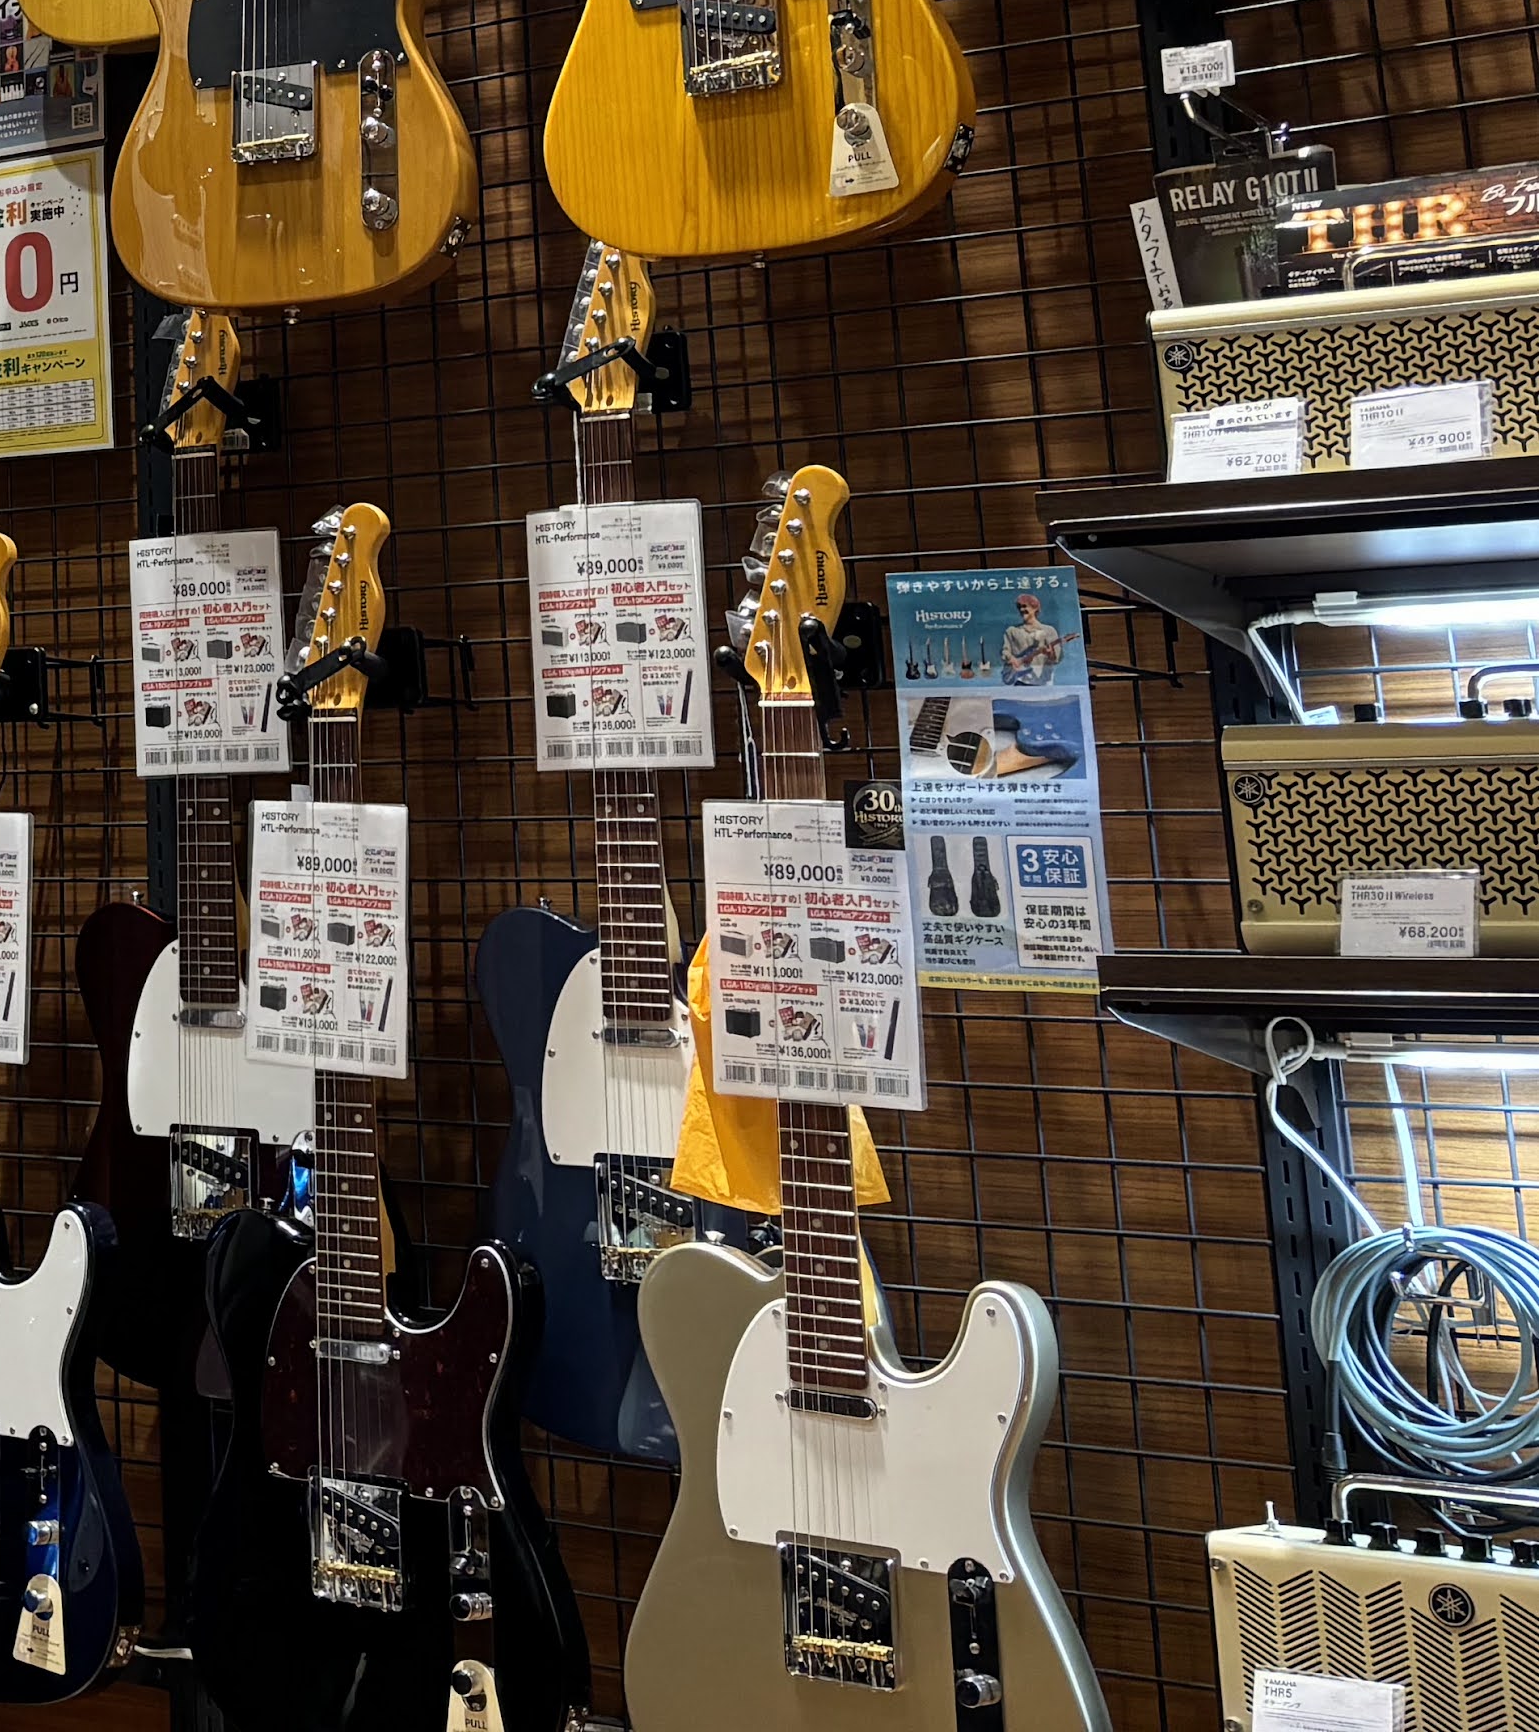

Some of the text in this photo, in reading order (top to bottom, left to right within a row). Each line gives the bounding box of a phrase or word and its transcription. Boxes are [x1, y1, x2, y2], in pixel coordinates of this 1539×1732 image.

[1480, 184, 1506, 202] Be
[30, 206, 65, 223] 実施中
[1287, 194, 1469, 254] THR
[577, 557, 637, 576] ¥89,000
[815, 549, 829, 607] HISTORY
[896, 575, 1069, 594] 弾きやすいから上達する。
[173, 580, 226, 596] ¥89,000
[648, 647, 695, 660] ¥123,000
[912, 782, 1063, 794] 上達をサポートする弾きやすさ
[714, 829, 793, 840] HTL-Performance
[297, 854, 352, 874] ¥89,000
[1042, 849, 1079, 865] 安心
[764, 863, 836, 883] ¥89,000
[1044, 867, 1081, 884] 保証
[1025, 904, 1087, 917] 保証期間は
[1023, 918, 1092, 931] 安心の3年間
[847, 970, 902, 986] ¥123,000
[778, 1045, 831, 1060] ¥136,000
[1264, 1678, 1297, 1689] YAMAHA
[1264, 1686, 1293, 1699] THR5
